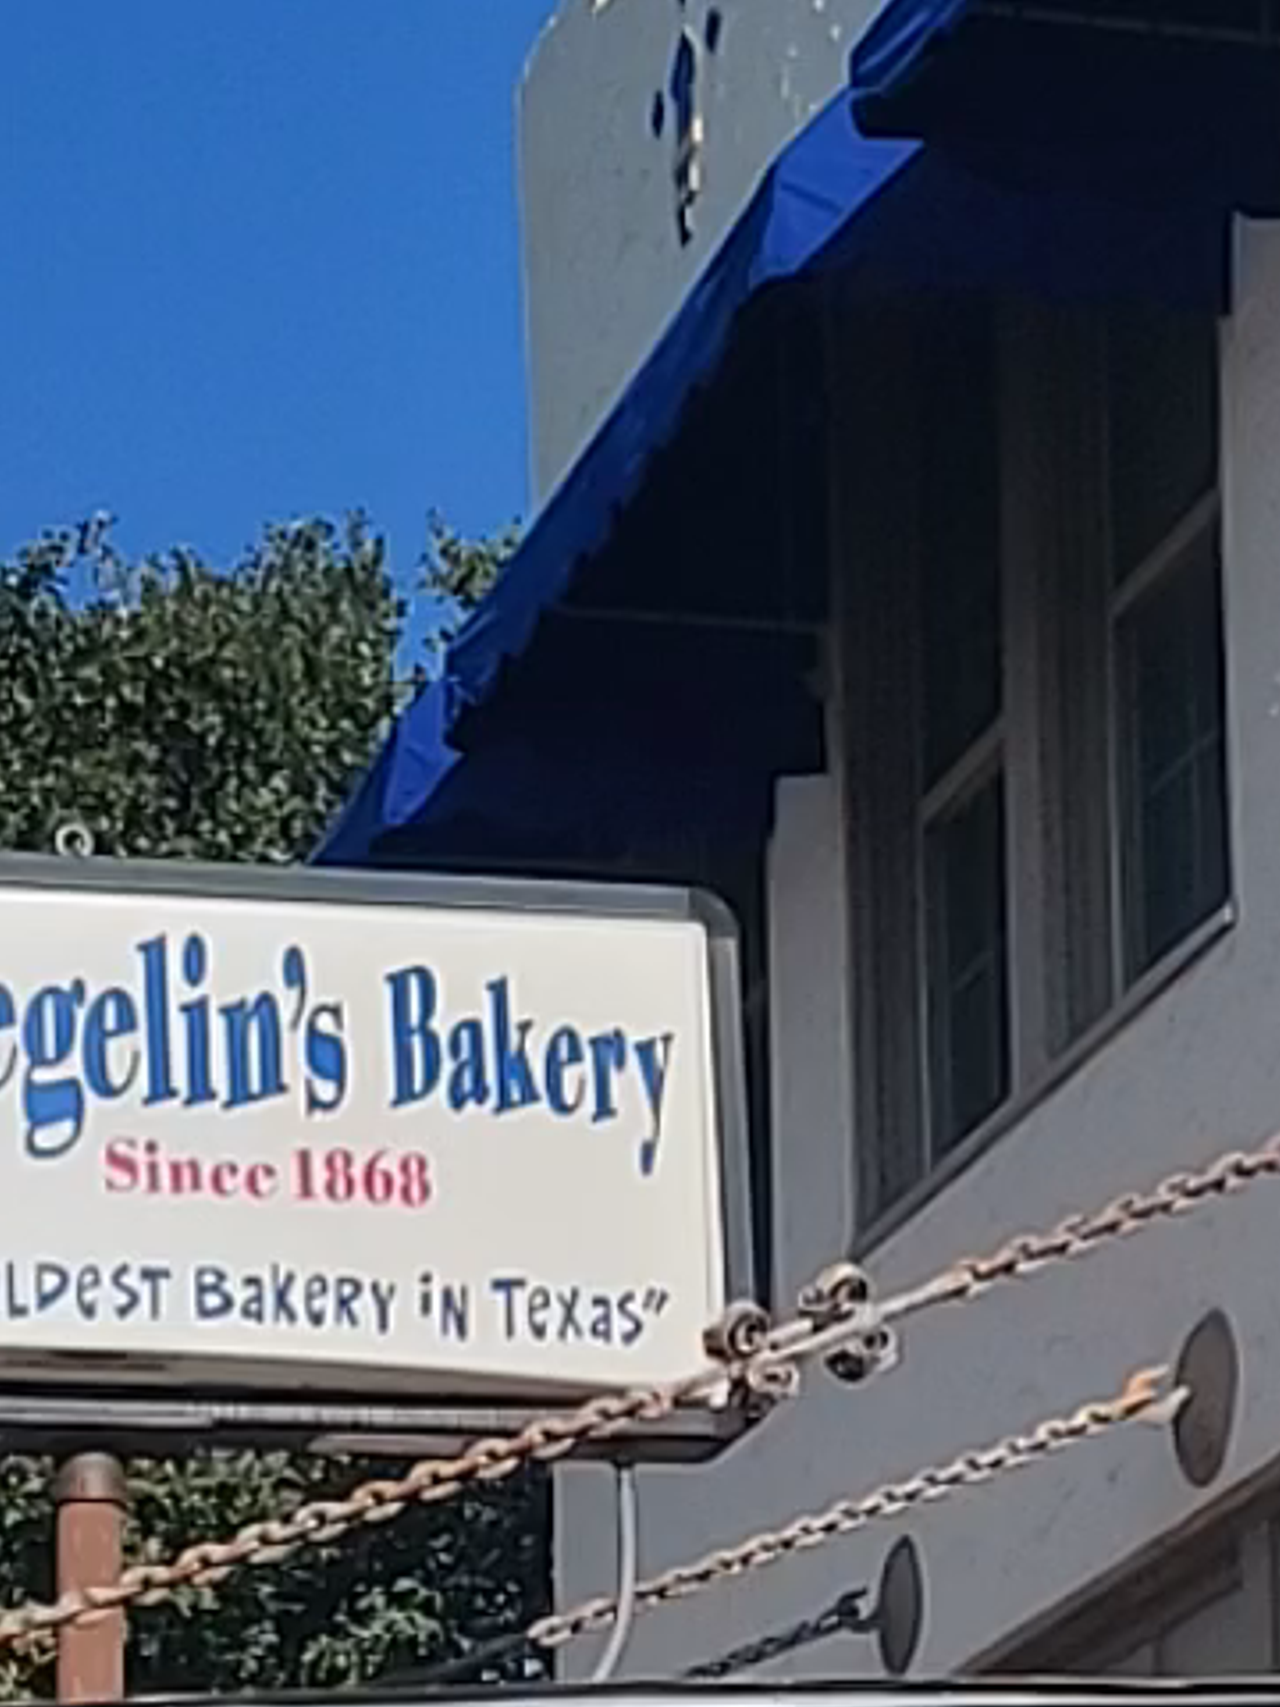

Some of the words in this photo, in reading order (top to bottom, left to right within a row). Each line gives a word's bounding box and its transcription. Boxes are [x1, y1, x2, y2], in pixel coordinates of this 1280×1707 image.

[383, 960, 676, 1176] Bakery
[103, 1137, 277, 1202] Since
[291, 1148, 433, 1209] 1868
